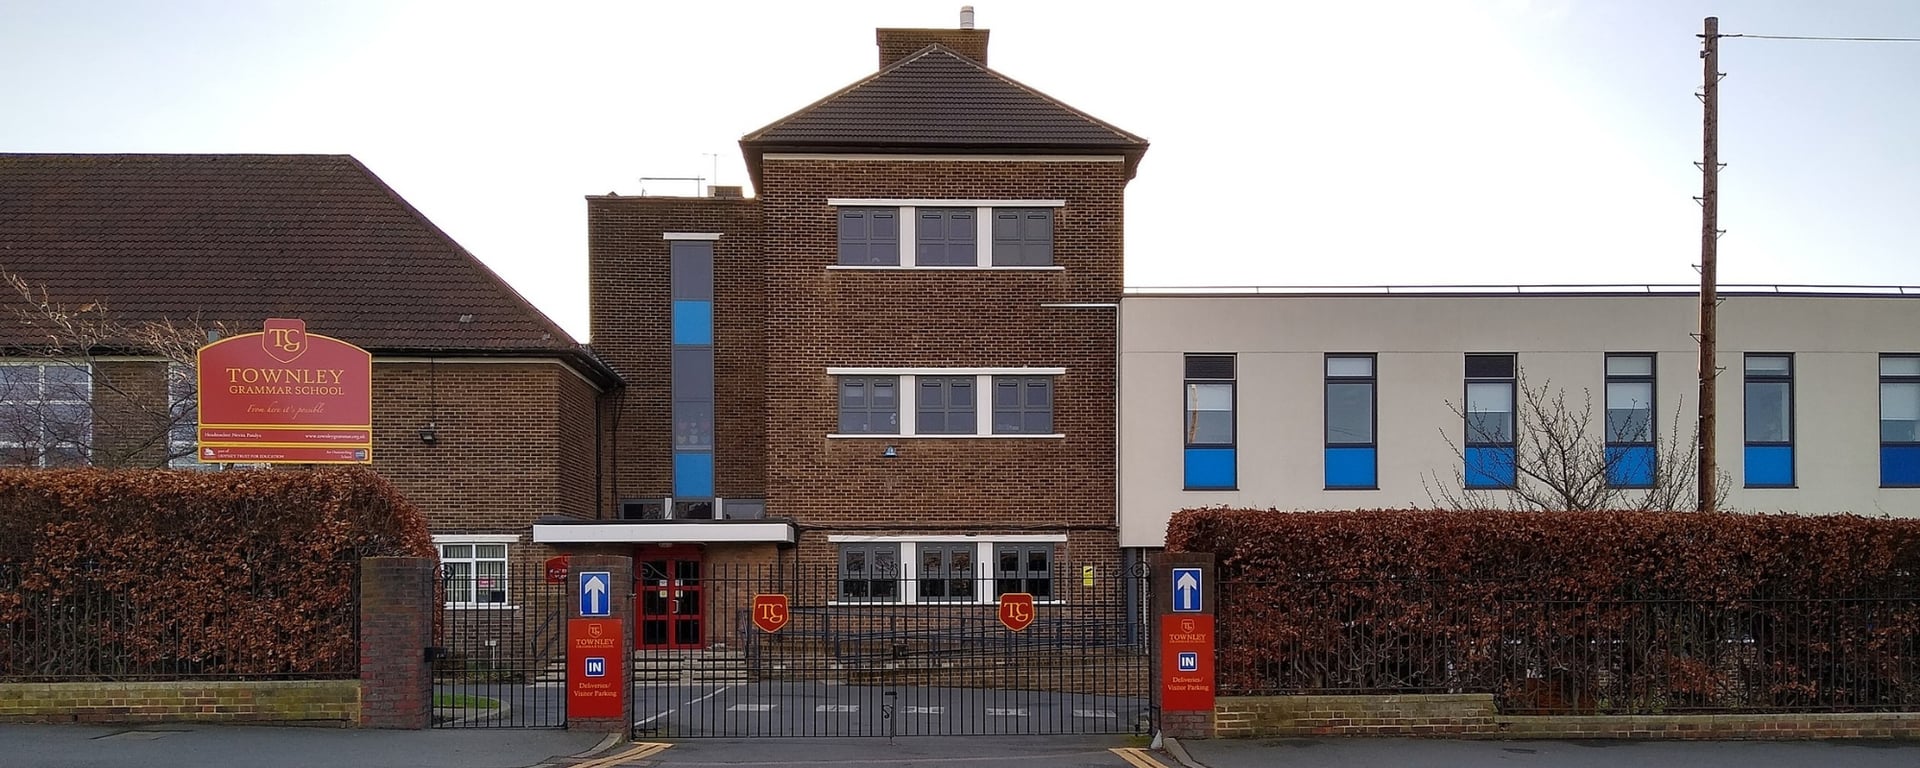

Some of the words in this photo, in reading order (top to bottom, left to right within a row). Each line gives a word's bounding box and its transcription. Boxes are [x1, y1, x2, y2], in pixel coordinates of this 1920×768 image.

[226, 368, 344, 384] TOWNLEY
[229, 385, 292, 395] GRAMMAR
[295, 386, 344, 395] SCHOOL
[247, 404, 264, 413] From
[292, 402, 325, 420] possible
[588, 662, 602, 672] IN
[1181, 657, 1194, 667] IN
[1187, 684, 1209, 692] Parking
[594, 690, 617, 698] Parking
